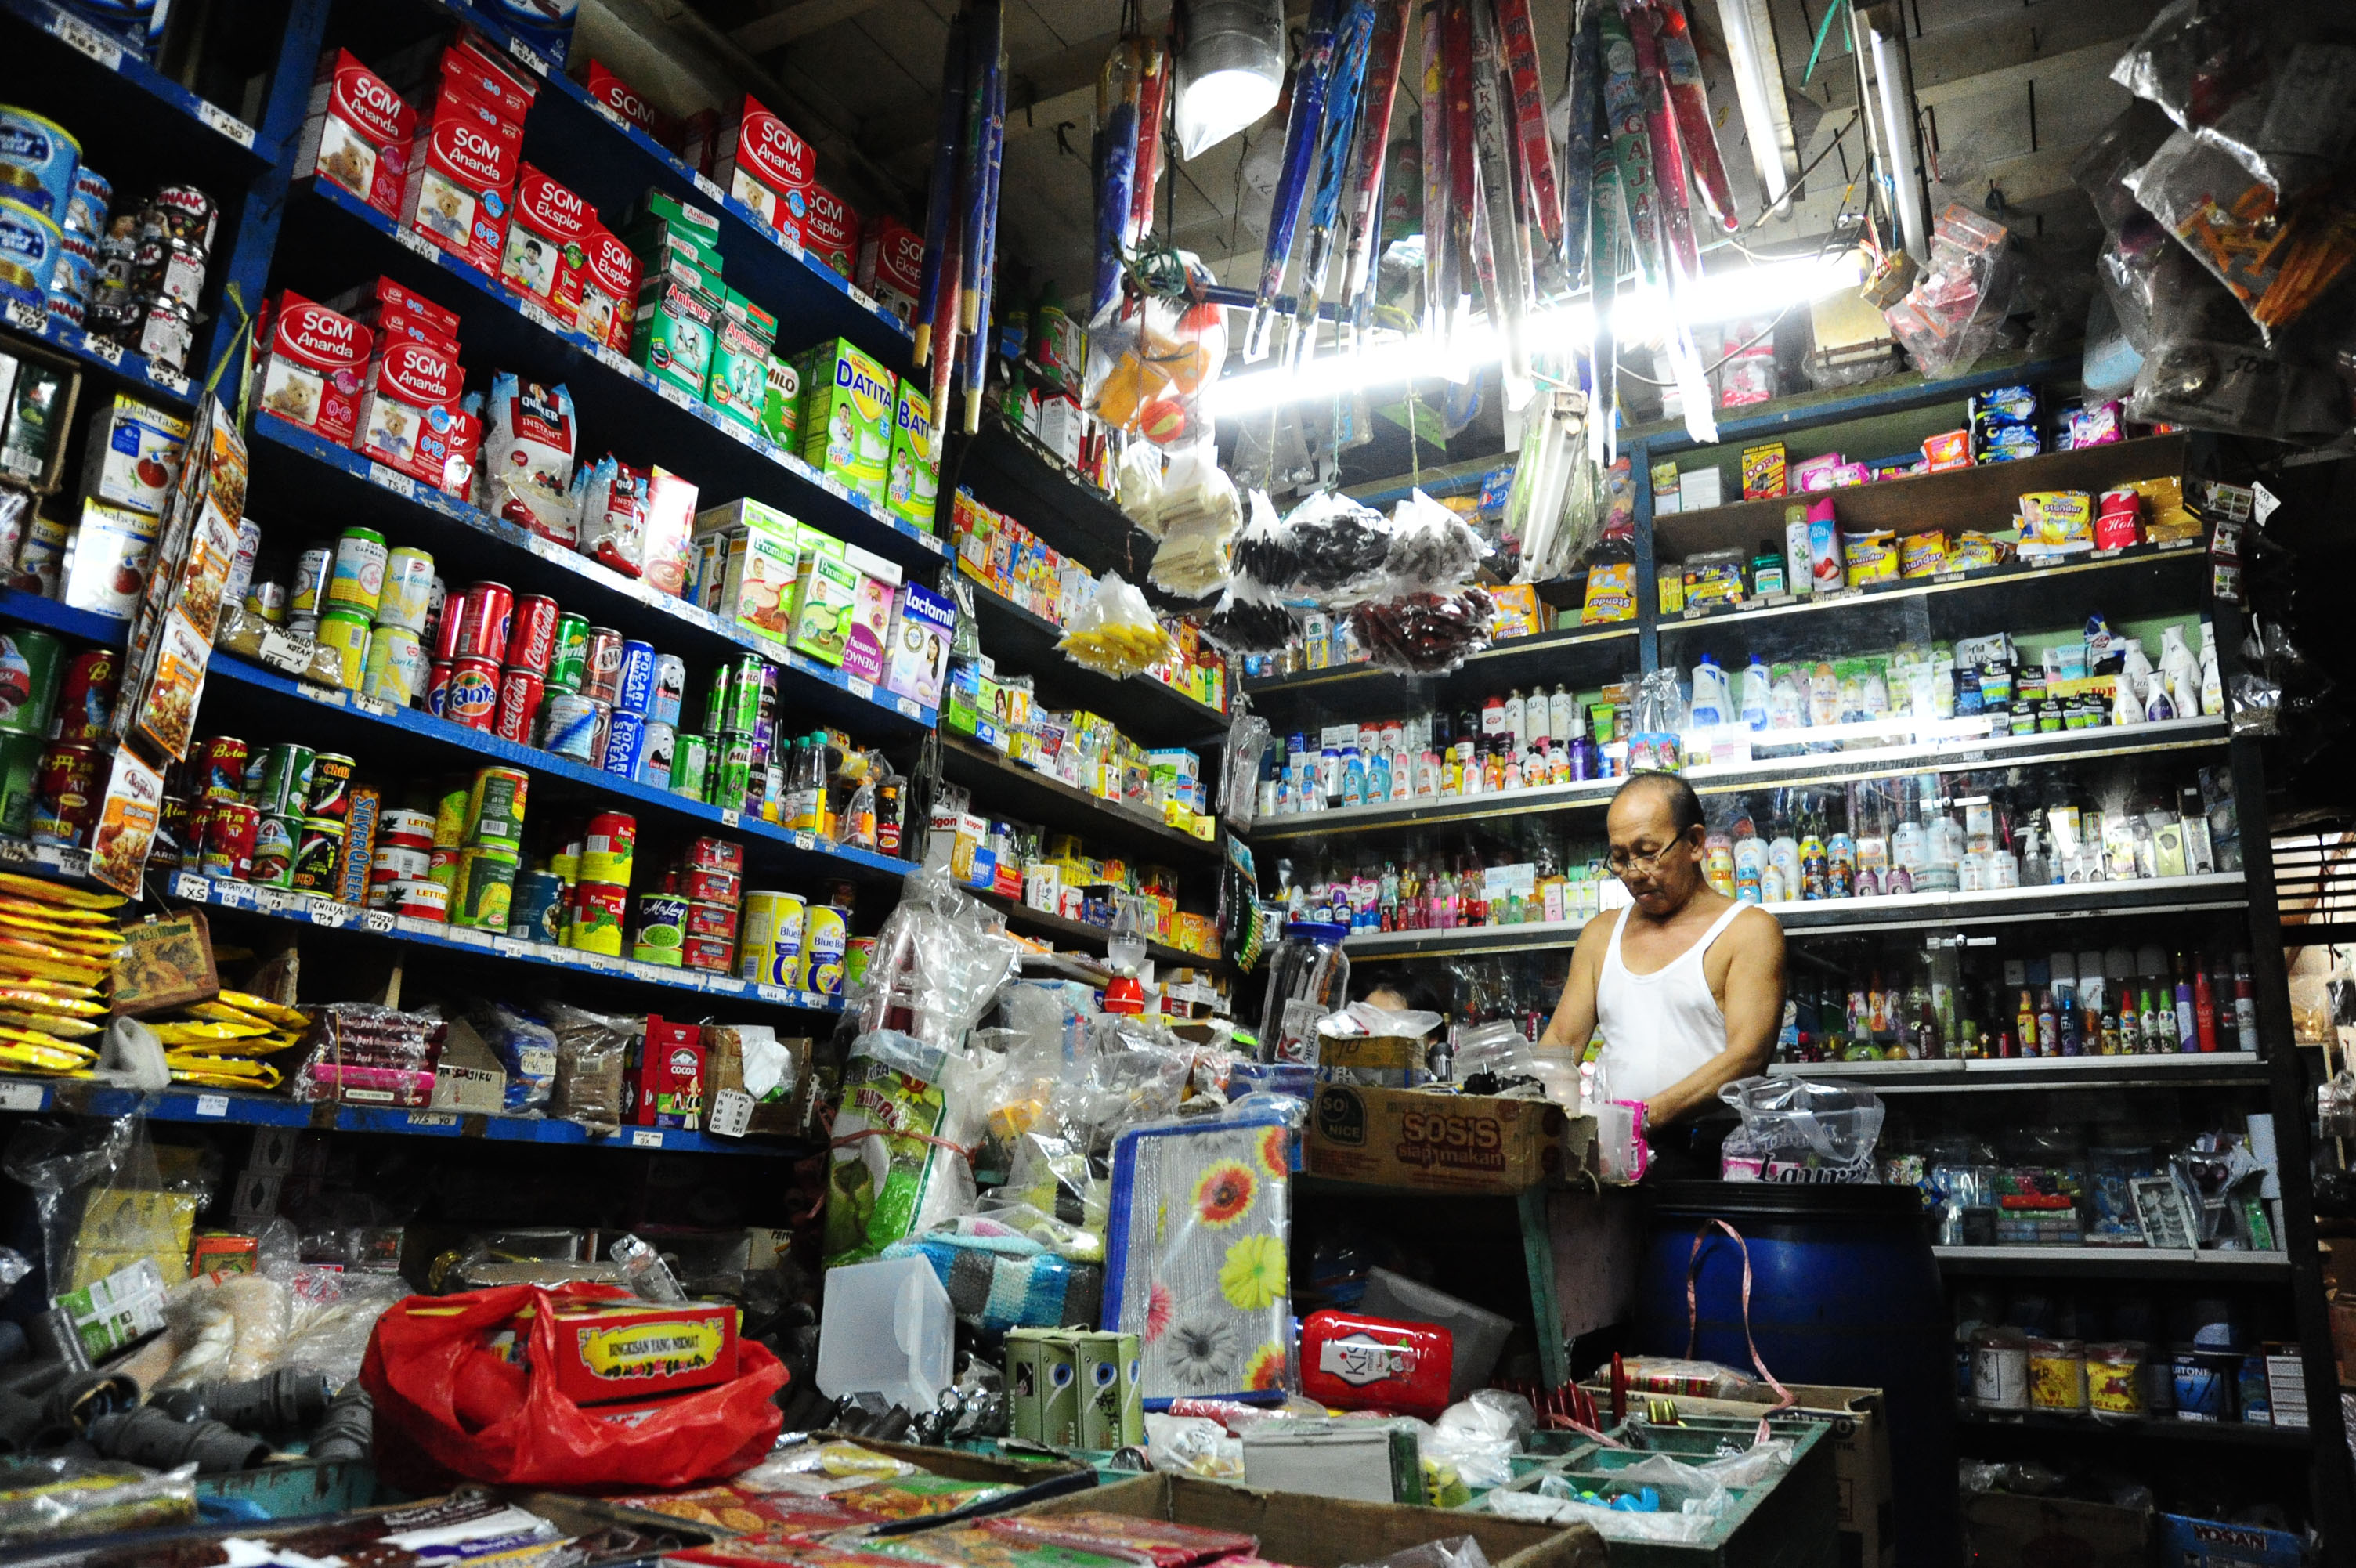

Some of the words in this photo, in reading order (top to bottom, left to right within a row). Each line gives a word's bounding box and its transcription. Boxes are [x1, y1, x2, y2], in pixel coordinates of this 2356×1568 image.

[354, 76, 402, 119] SGM
[609, 86, 656, 127] SGM
[350, 99, 399, 138] Ananda
[453, 127, 500, 163] SGM
[761, 121, 803, 161] SGM
[449, 147, 500, 182] Ananda
[757, 143, 803, 182] Ananda
[540, 182, 584, 216] SGM
[536, 201, 583, 234] Eksplor
[687, 207, 715, 227] Anlene
[474, 220, 500, 250] 6-12
[602, 239, 633, 273] SGM
[598, 259, 633, 288] Eksplor
[666, 283, 712, 323] Anlene
[302, 311, 354, 342] SGM
[725, 320, 765, 359] Anlene
[297, 331, 354, 359] Ananda
[403, 349, 447, 380] SGM
[398, 372, 447, 398] Ananda
[835, 359, 893, 411] DATITA
[326, 399, 352, 423] 0-6
[521, 396, 559, 422] QUAKER
[898, 399, 930, 442] BATI
[522, 417, 562, 440] INSTANT
[421, 435, 446, 460] 6-12
[89, 502, 157, 532] Diabetaso
[755, 537, 795, 565] Promina
[819, 558, 855, 589] Promina
[905, 587, 956, 627] Lactamil
[286, 643, 312, 658] KOTAK
[845, 649, 880, 673] PRENAG
[635, 650, 656, 710] POCARI
[446, 683, 496, 709] fanta
[607, 719, 626, 772] SWEAT
[323, 763, 351, 779] Chili
[407, 818, 435, 829] LETTU
[930, 816, 958, 829] tigon
[186, 887, 205, 900] XS
[416, 887, 447, 899] LETTUC
[780, 926, 797, 938] Blue
[814, 937, 833, 948] Blue
[360, 1018, 378, 1030] Dark
[356, 1034, 374, 1046] Dark
[355, 1052, 373, 1064] Dark
[670, 1065, 696, 1075] cocoa
[1321, 1098, 1345, 1115] SO
[1328, 1124, 1362, 1139] NICE
[1403, 1114, 1501, 1148] SOSIS
[1440, 1147, 1504, 1166] makan
[649, 1336, 673, 1354] YANG
[673, 1334, 700, 1350] NIKMAT
[2192, 1526, 2267, 1552] YOSAN
